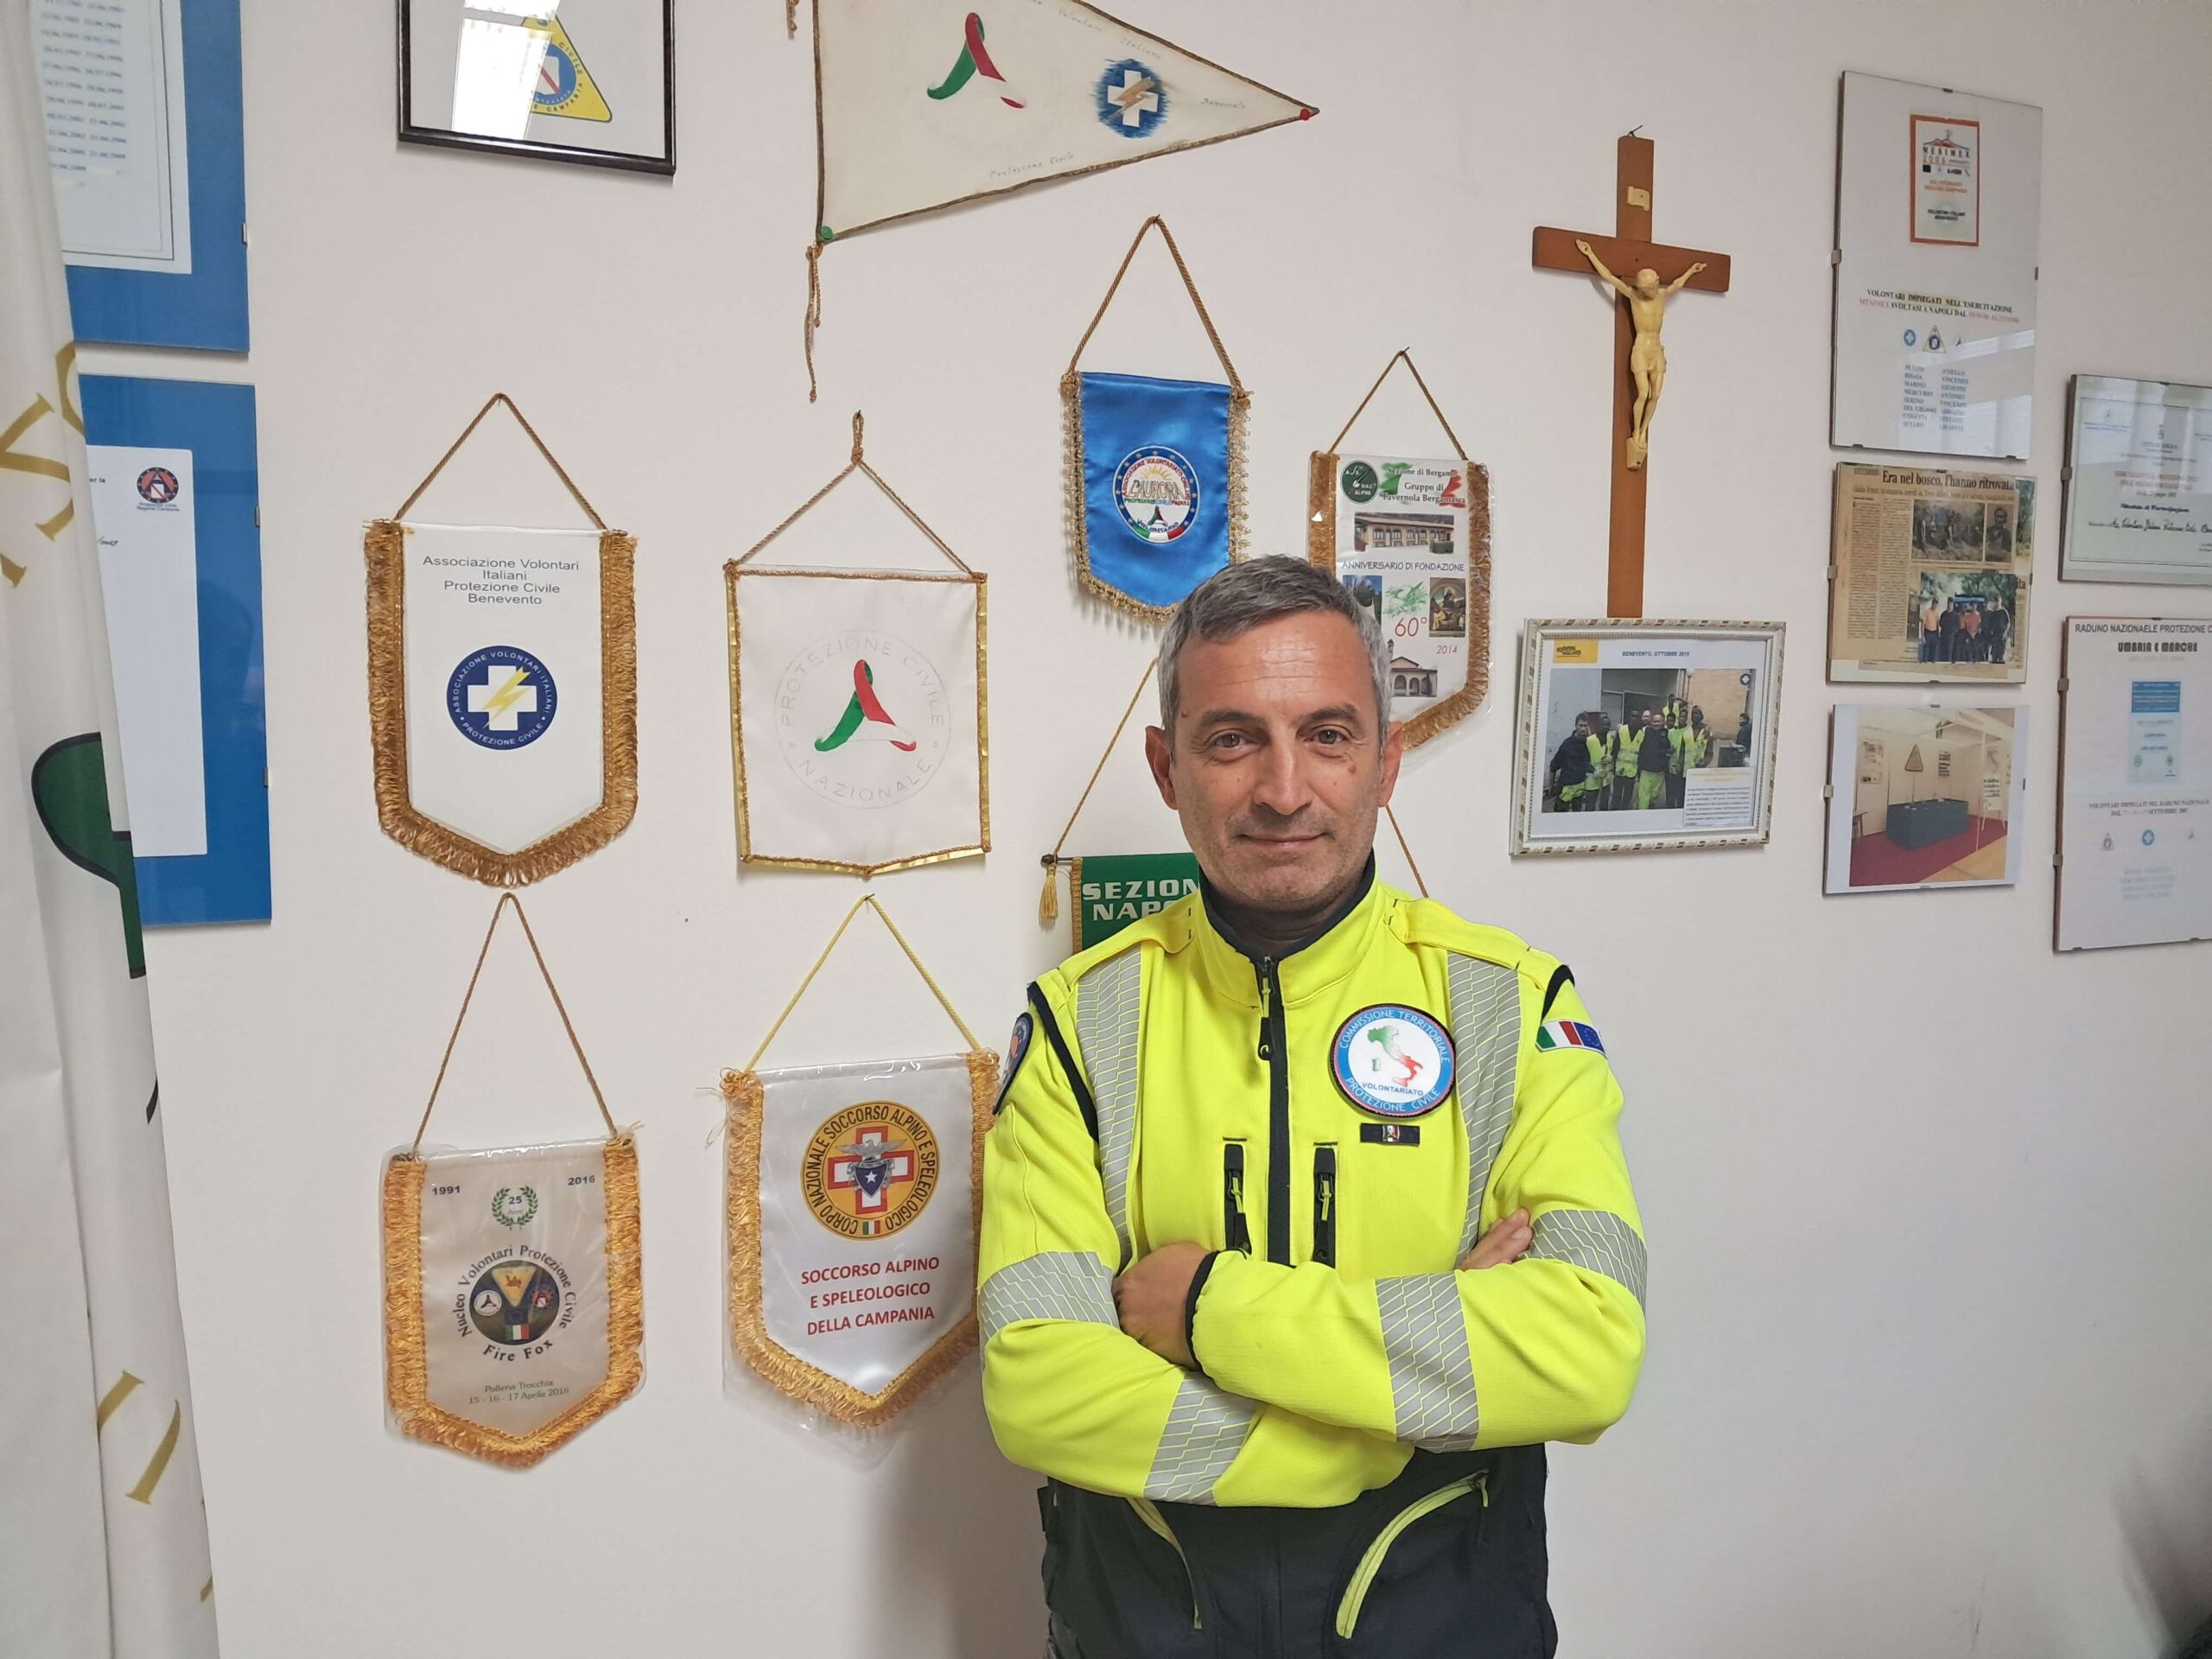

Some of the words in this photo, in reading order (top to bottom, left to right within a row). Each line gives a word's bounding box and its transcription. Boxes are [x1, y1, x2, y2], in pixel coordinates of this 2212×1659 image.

[1867, 289, 1905, 301] VOLONTARI
[1908, 293, 1942, 304] IMPIEGATI
[1929, 307, 1953, 315] NAPOLI
[1883, 470, 1897, 484] Era
[1900, 472, 1914, 485] nel
[1404, 482, 1434, 493] Gruppo
[1422, 494, 1465, 504] Bergamasca
[423, 556, 516, 568] Associazione
[520, 559, 580, 571] Volontari
[1341, 561, 1403, 570] ANNIVERSARIO
[1415, 563, 1465, 571] FONDAZIONE
[483, 570, 527, 581] Italiani
[444, 581, 519, 593] Protezione
[523, 583, 561, 594] Civile
[467, 593, 542, 605] Benevento
[2075, 624, 2108, 632] RADUNO
[2110, 624, 2158, 633] NAZIONAELE
[2160, 625, 2205, 633] PROTEZIONE
[1436, 645, 1458, 654] 2014
[2118, 642, 2152, 652] UMBRIA
[2161, 642, 2198, 652] MARCHE
[453, 654, 486, 713] ASSOCIAZIONE
[490, 651, 542, 674] VOLONTARI
[539, 675, 552, 714] ITALIANI
[781, 635, 893, 727] PROTEZIONE
[903, 657, 944, 726] CIVILE
[462, 721, 516, 746] PROTEZIONE
[518, 723, 543, 742] CIVILE
[798, 758, 931, 802] NAZIONALE
[1339, 1009, 1395, 1049] COMMISSIONE
[1398, 1010, 1450, 1064] TERRITORIALE
[1344, 1077, 1407, 1112] PROTEZIONE
[1411, 1089, 1441, 1109] CIVILE
[1362, 1082, 1424, 1096] VOLONTARIATO
[823, 1105, 889, 1140] SOCCORSO
[890, 1109, 927, 1141] ALPINO
[918, 1140, 933, 1151] E
[568, 1175, 595, 1185] 2016
[805, 1137, 830, 1208] NAZIONALE
[432, 1185, 461, 1195] 1991
[884, 1152, 936, 1231] SPELEOLOGICO
[508, 1196, 523, 1205] 25
[820, 1205, 859, 1235] CORPO
[458, 1244, 513, 1286] Volontari
[519, 1244, 571, 1288] Protezione
[801, 1262, 881, 1285] SOCCORSO
[885, 1256, 940, 1274] ALPINO
[810, 1295, 818, 1309] E
[822, 1281, 931, 1307] SPELEOLOGICO
[453, 1294, 472, 1338] Nucleo
[559, 1292, 576, 1329] Civile
[807, 1316, 851, 1336] DELLA
[855, 1306, 935, 1327] CAMPANIA
[482, 1344, 516, 1361] Fire
[524, 1339, 553, 1359] Fox
[485, 1384, 516, 1393] Pollena
[519, 1380, 553, 1389] Trocchia
[521, 1390, 546, 1401] Aprile
[548, 1387, 569, 1397] 2016
